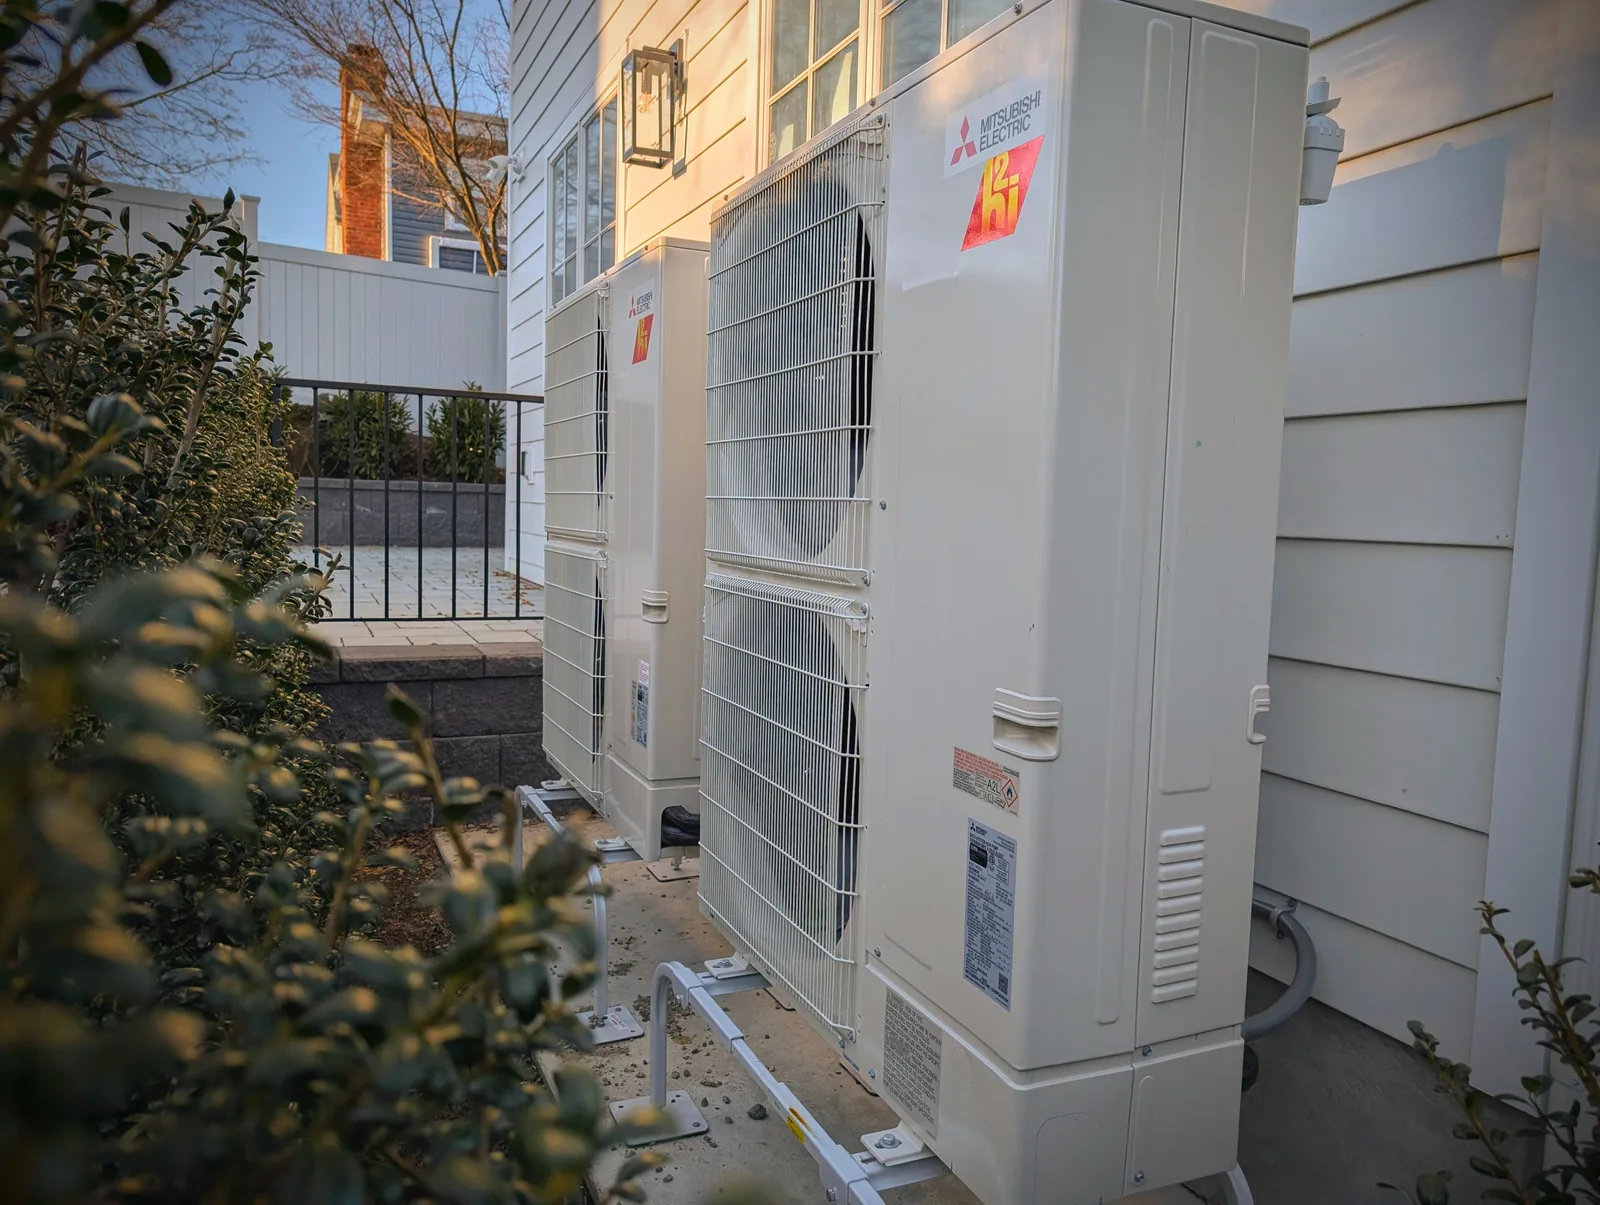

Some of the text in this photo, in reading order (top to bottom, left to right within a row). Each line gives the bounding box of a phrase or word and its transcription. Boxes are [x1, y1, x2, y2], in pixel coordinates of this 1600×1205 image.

[980, 90, 1041, 134] MITSUBISHI
[979, 115, 1031, 152] ELECTRIC
[986, 779, 1001, 794] A2L
